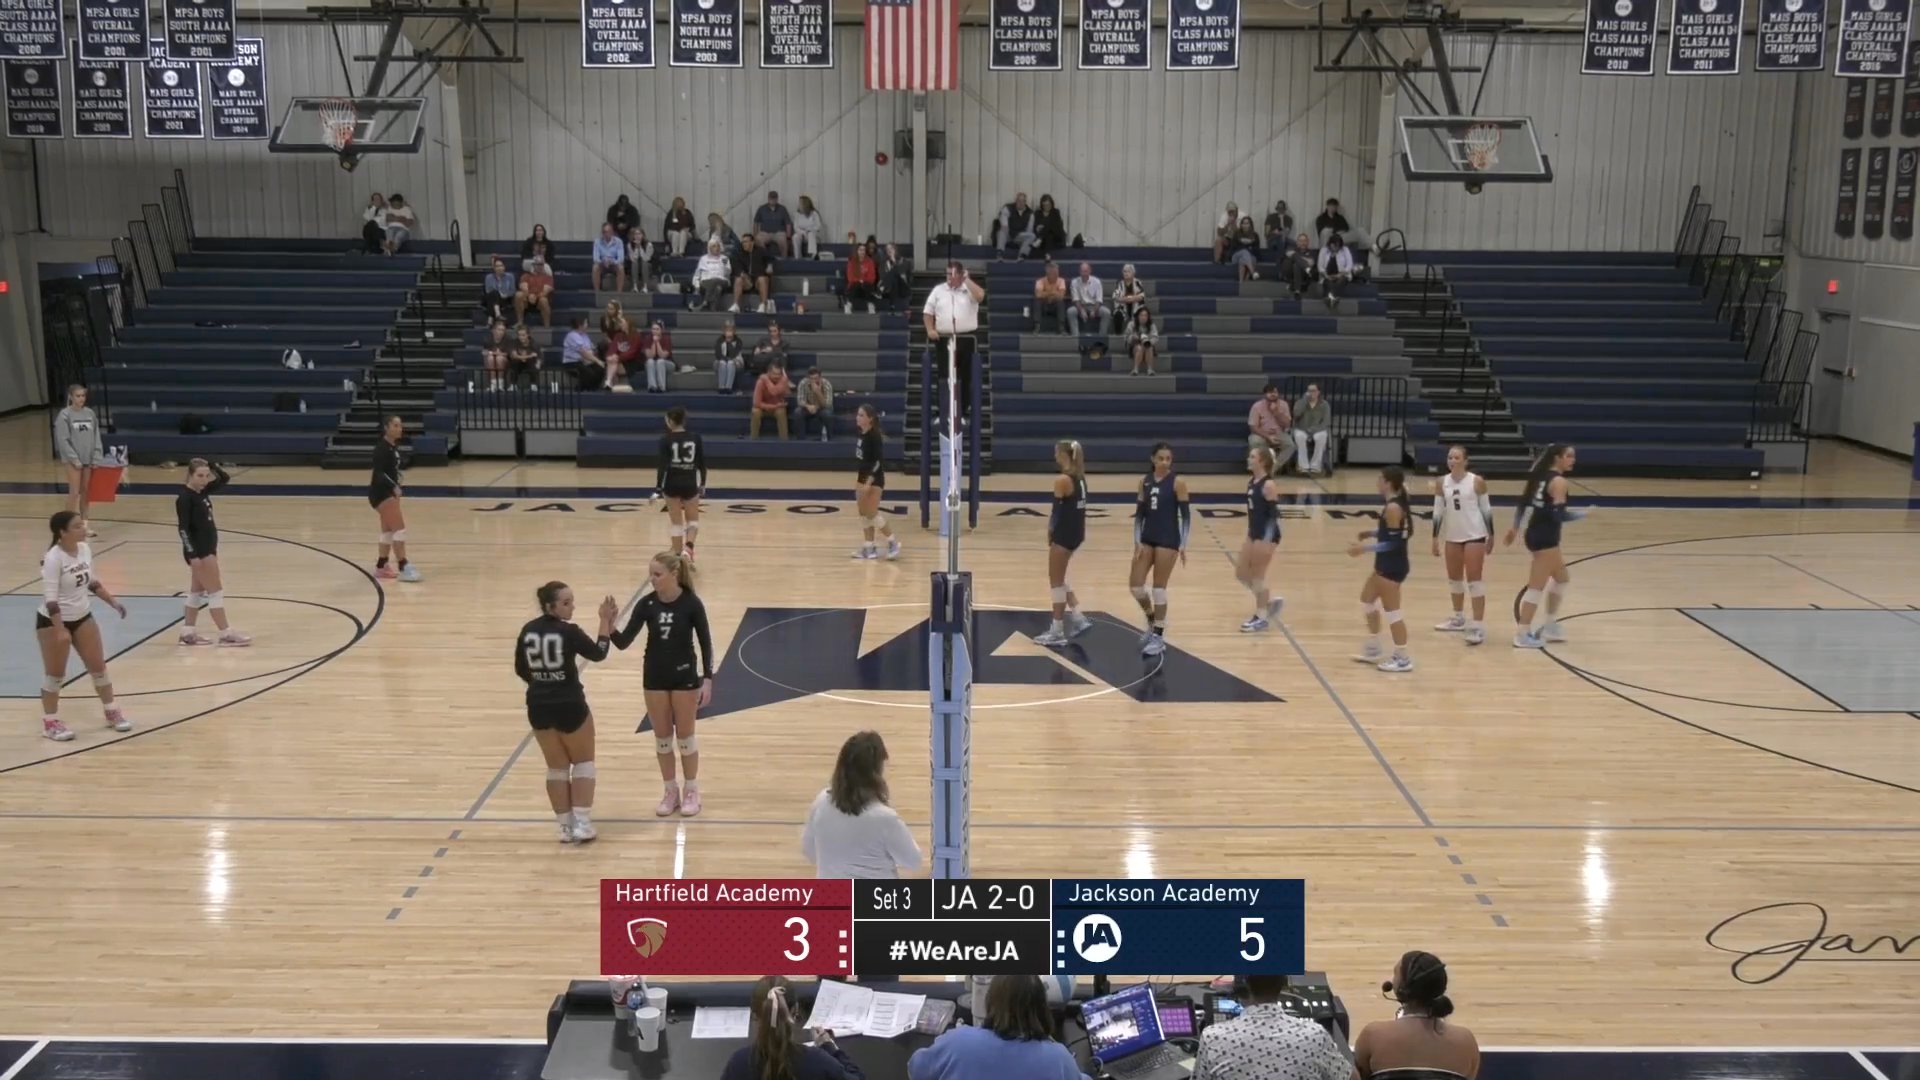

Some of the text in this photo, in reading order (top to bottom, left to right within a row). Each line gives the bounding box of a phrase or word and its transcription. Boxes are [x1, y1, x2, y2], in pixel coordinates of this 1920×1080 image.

[86, 7, 140, 18] MPSA GIRLS
[175, 8, 225, 18] MPSA BOYS
[592, 8, 643, 18] MPSA GIRLS
[770, 5, 822, 15] MPSA BOYS
[1091, 9, 1140, 19] MPSA BOYS
[0, 11, 57, 20] SOUTH AAAA
[681, 13, 732, 24] MPSA BOYS
[770, 15, 823, 25] NORTH AAA
[1681, 14, 1733, 24] MAIS GIRLS
[1770, 13, 1818, 22] MAIS BOYS
[1851, 12, 1902, 21] MAIS GIRLS
[92, 20, 135, 30] OVERALL
[170, 21, 231, 31] SOUTH AAAA
[588, 19, 647, 29] SOUTH AAAA
[1000, 16, 1052, 26] MPSA BOYS
[1084, 20, 1112, 31] CLASS
[1114, 21, 1133, 31] AAA
[1180, 16, 1229, 27] MPSA BOYS
[1596, 20, 1648, 31] MAIS GIRLS
[31, 22, 57, 31] AAAA
[680, 26, 733, 37] NORTH AAA
[770, 26, 822, 35] CLASS AAA
[1675, 26, 1704, 35] CLASS
[1705, 26, 1725, 35] AAA
[1761, 23, 1789, 33] CLASS
[1790, 23, 1810, 33] AAA
[1843, 22, 1868, 31] CLASS
[1870, 22, 1894, 31] AAAA
[4, 33, 55, 43] CHAMPIONS
[88, 33, 141, 43] CHAMPIONS
[175, 34, 227, 43] CHAMPIONS
[597, 30, 639, 40] OVERALL
[995, 29, 1023, 39] CLASS
[1025, 29, 1045, 39] AAA
[1093, 32, 1136, 42] OVERALL
[1172, 29, 1201, 39] CLASS
[1203, 29, 1223, 39] AAA
[1589, 33, 1618, 43] CLASS
[1619, 34, 1639, 44] AAA
[1765, 34, 1817, 43] CLASS AAA
[1844, 32, 1902, 41] CLASS AAAA
[680, 39, 732, 50] CHAMPIONS
[775, 35, 818, 45] OVERALL
[1679, 37, 1730, 47] CLASS AAA
[18, 44, 41, 54] 2000
[104, 46, 126, 56] 2001
[593, 42, 644, 52] CHAMPIONS
[771, 45, 822, 54] CHAMPIONS
[1000, 42, 1051, 52] CHAMPIONS
[1089, 43, 1140, 53] CHAMPIONS
[1177, 41, 1229, 52] CHAMPIONS
[1594, 46, 1645, 57] CHAMPIONS
[1764, 44, 1817, 54] CHAMPIONS
[1851, 42, 1893, 51] OVERALL
[190, 47, 212, 57] 2001
[695, 52, 717, 62] 2003
[1679, 48, 1730, 58] CHAMPIONS
[1845, 51, 1897, 62] CHAMPIONS
[607, 53, 630, 63] 2002
[784, 55, 808, 64] 2004
[1014, 55, 1037, 65] 2005
[1103, 55, 1125, 65] 2006
[1191, 55, 1214, 65] 2007
[1778, 54, 1800, 64] 2014
[1607, 60, 1629, 70] 2010
[1693, 60, 1713, 69] 2011
[150, 89, 194, 97] MAIS GIRLS
[147, 100, 170, 108] CLASS
[151, 110, 196, 119] CHAMPIONS
[671, 441, 696, 463] 13
[470, 502, 908, 515] JACSON
[660, 626, 671, 639] 7
[524, 632, 565, 669] 20
